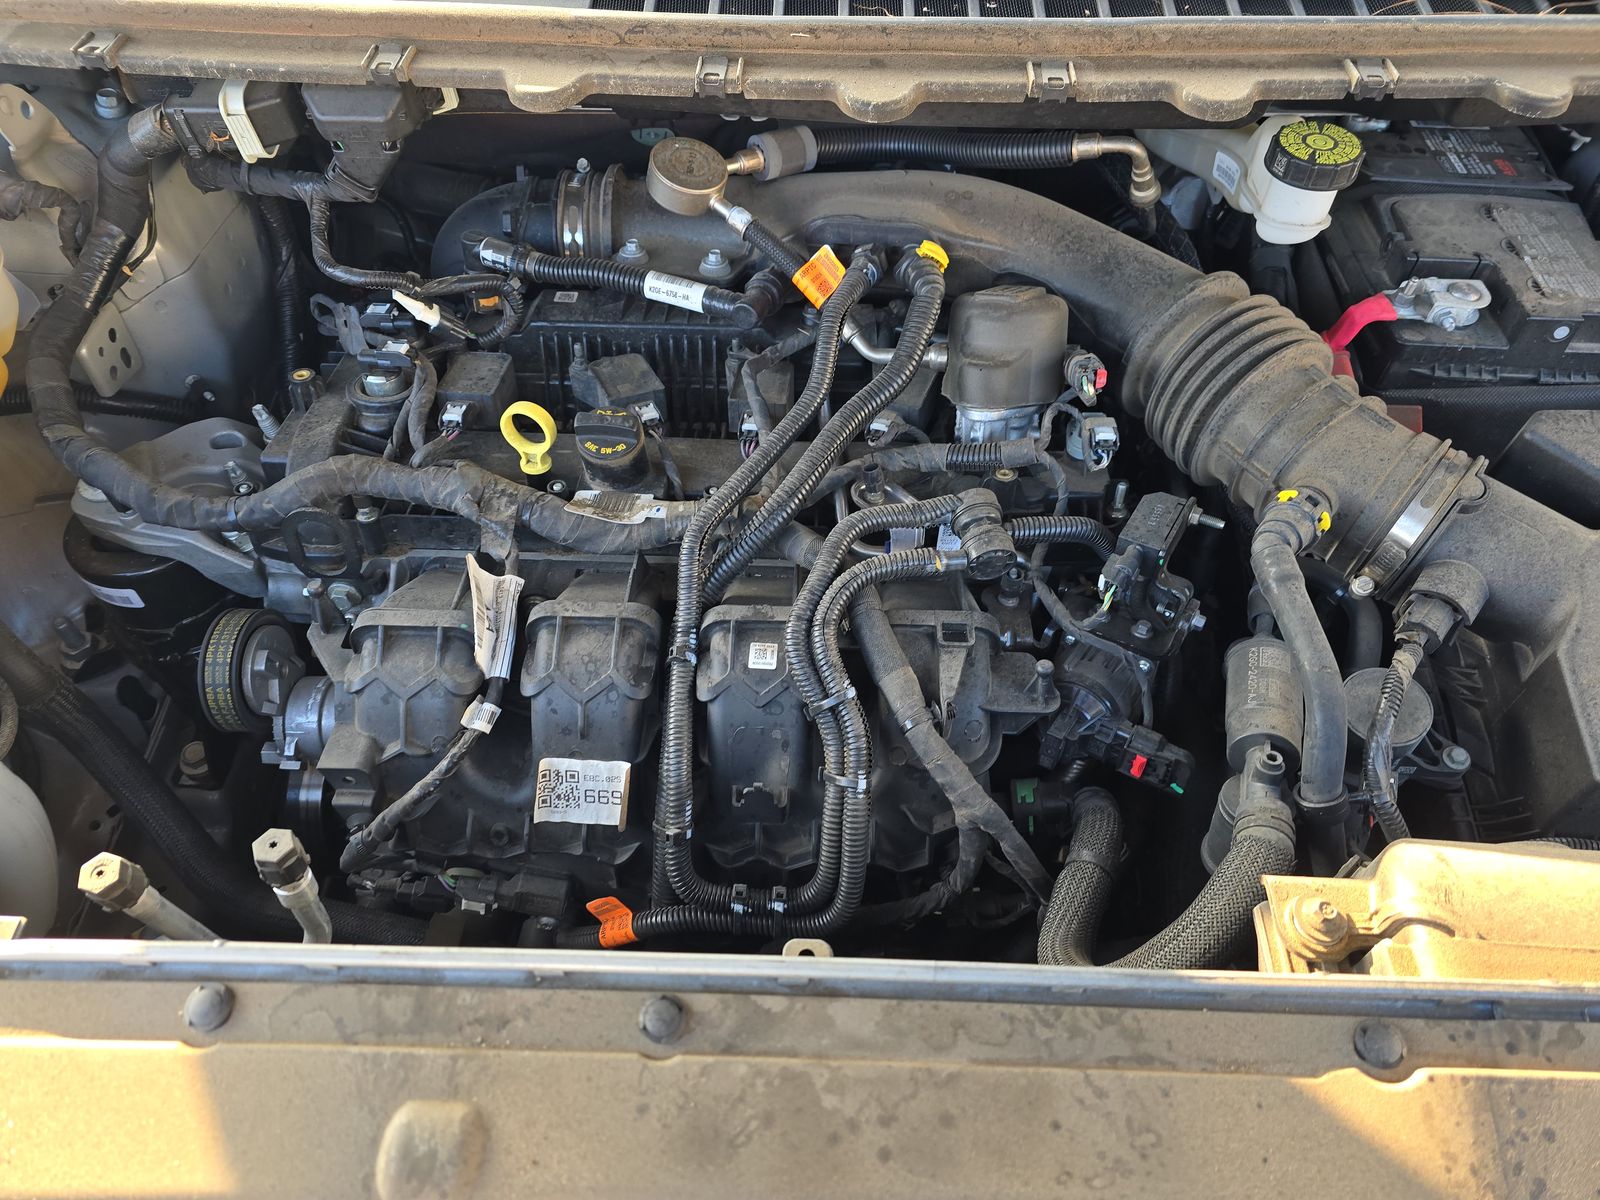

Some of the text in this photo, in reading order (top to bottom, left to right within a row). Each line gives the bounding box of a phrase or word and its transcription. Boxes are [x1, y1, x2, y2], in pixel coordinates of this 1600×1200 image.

[584, 441, 627, 454] SAE 5W-30
[584, 789, 623, 805] 669
